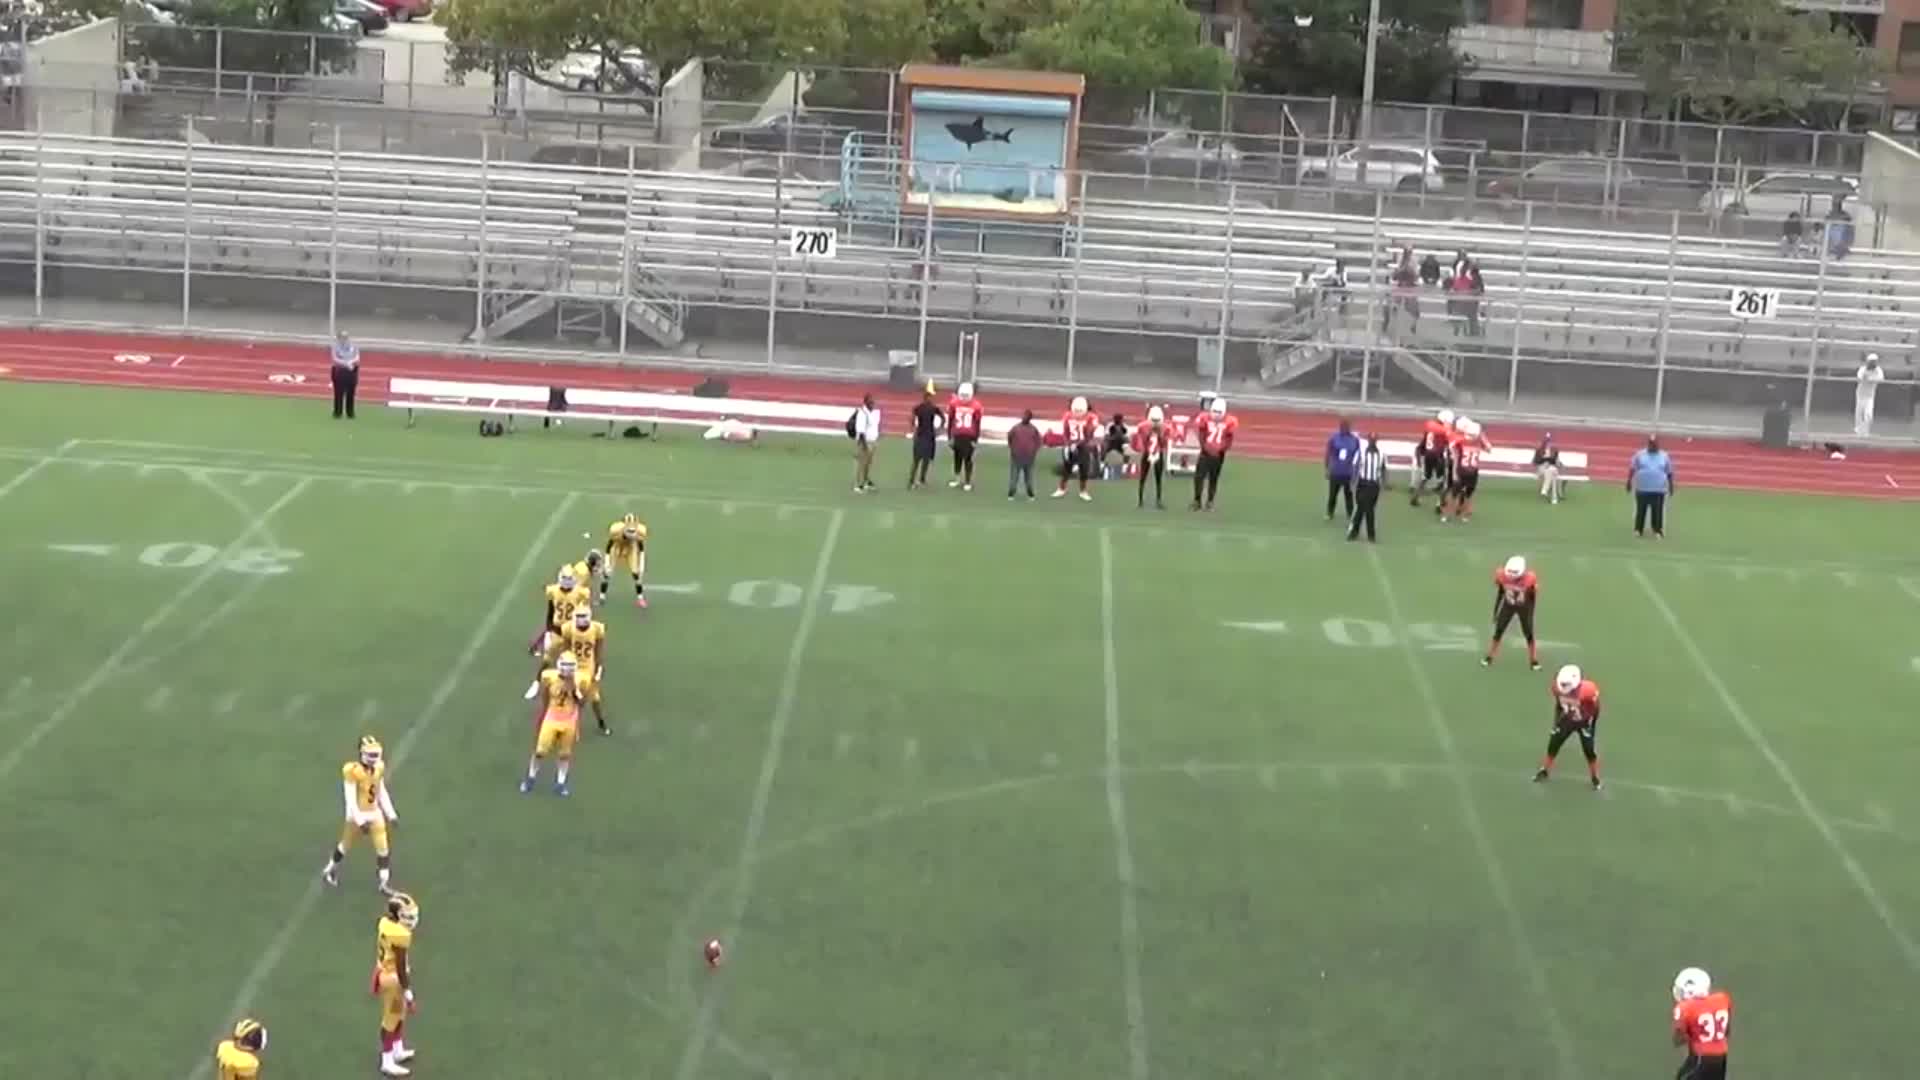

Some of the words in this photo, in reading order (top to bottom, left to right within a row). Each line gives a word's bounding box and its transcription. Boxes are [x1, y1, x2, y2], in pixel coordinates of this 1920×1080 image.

[796, 230, 833, 254] 270'
[1736, 290, 1775, 316] 261'
[556, 601, 575, 621] 52
